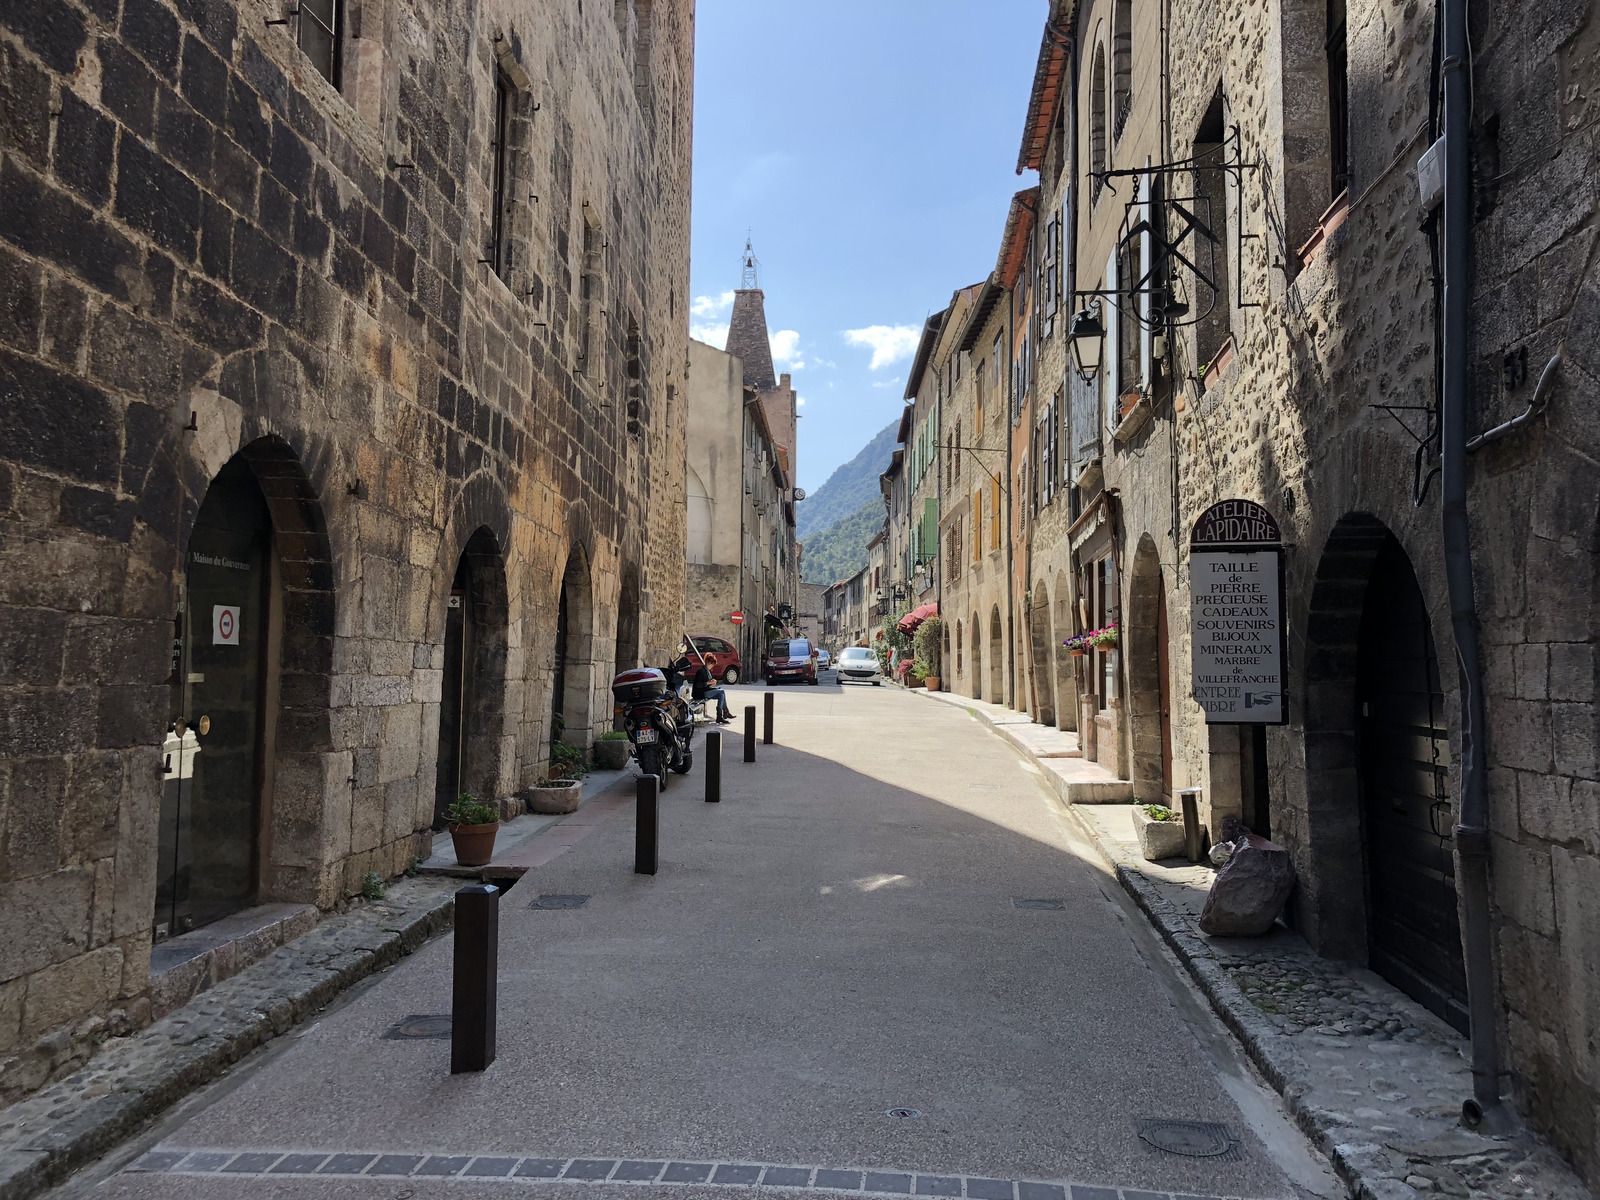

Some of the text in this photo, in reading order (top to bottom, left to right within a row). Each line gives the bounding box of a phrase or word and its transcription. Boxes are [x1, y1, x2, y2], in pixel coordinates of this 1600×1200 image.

[1204, 501, 1268, 524] ATELIER
[1196, 518, 1276, 542] LAPIDAIRE
[193, 551, 213, 565] Maison
[213, 555, 221, 566] du
[1209, 562, 1259, 573] TAILLE
[1228, 573, 1242, 583] de
[1210, 583, 1261, 594] PIERRE
[1195, 594, 1268, 605] PRECIEUSE
[1202, 607, 1269, 617] CADEAUX
[1196, 620, 1275, 630] SOUVENIRS
[1212, 632, 1260, 642] BIJOUX
[1200, 645, 1273, 655] MINERAUX
[1214, 657, 1261, 665] MARBRE
[1232, 666, 1243, 674] de
[1197, 675, 1279, 684] VILLEFRANCHE
[1194, 686, 1241, 698] ENTREE
